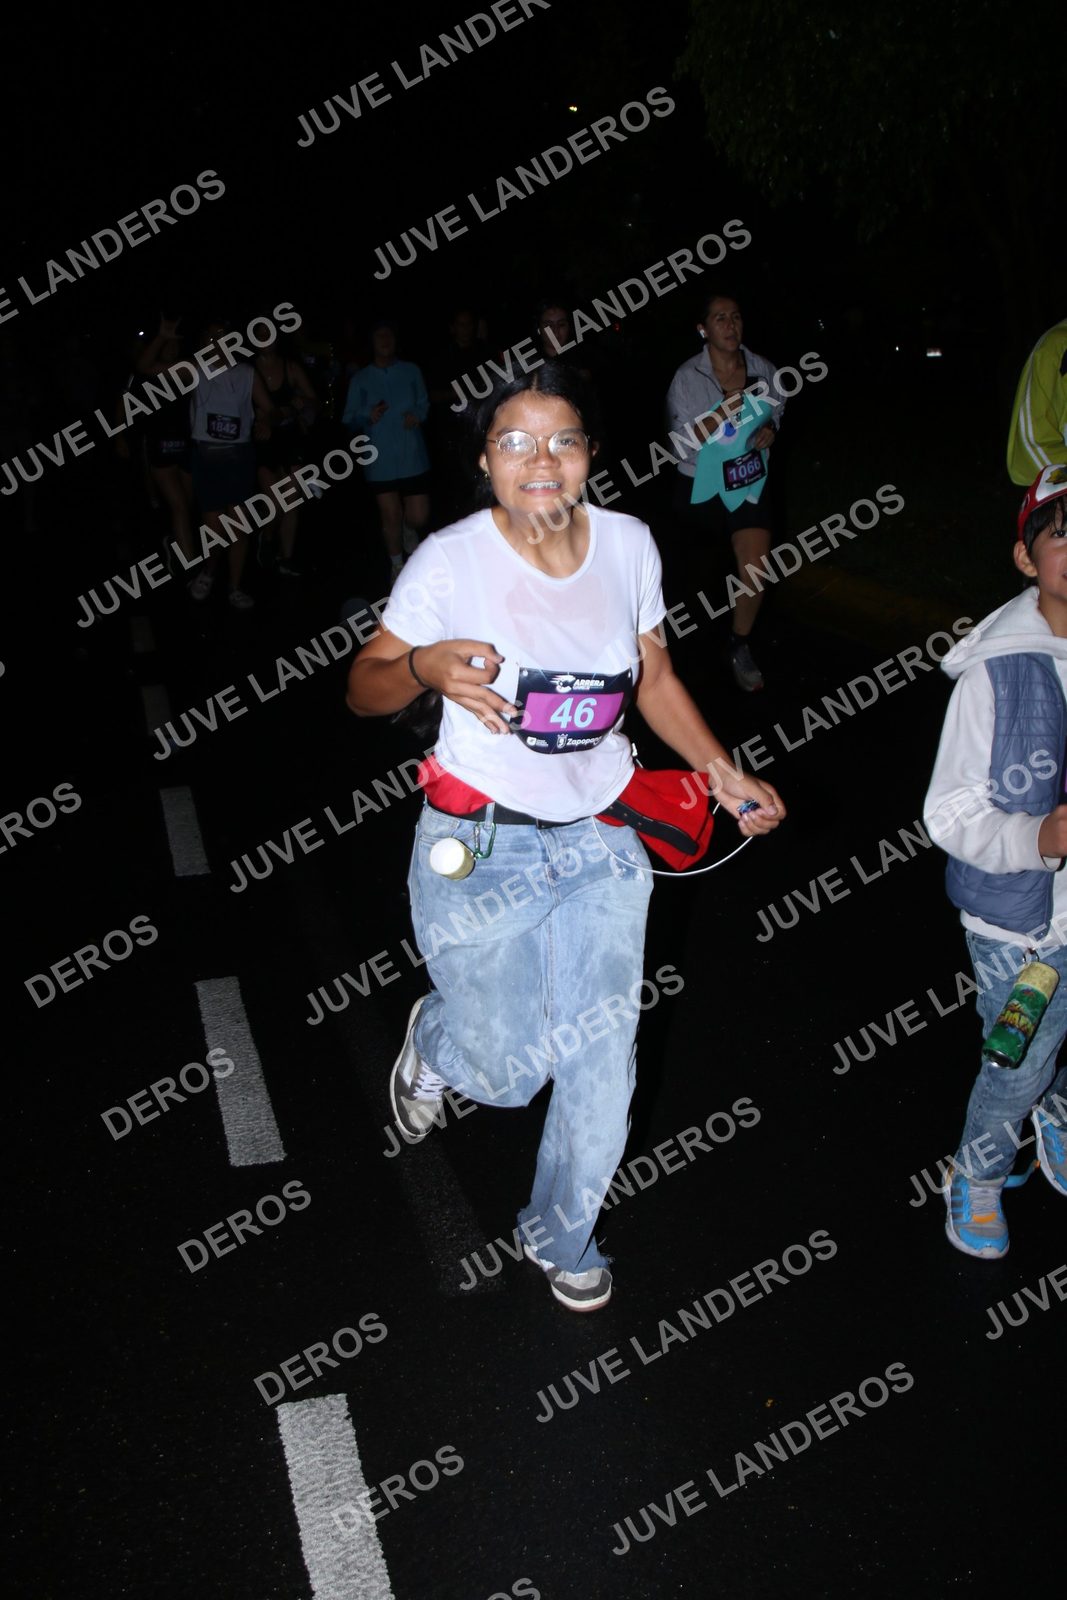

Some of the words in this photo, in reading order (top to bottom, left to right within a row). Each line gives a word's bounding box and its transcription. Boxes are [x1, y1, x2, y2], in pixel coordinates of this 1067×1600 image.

[210, 420, 237, 434] 1842
[728, 456, 761, 481] 1066
[550, 697, 597, 729] 46
